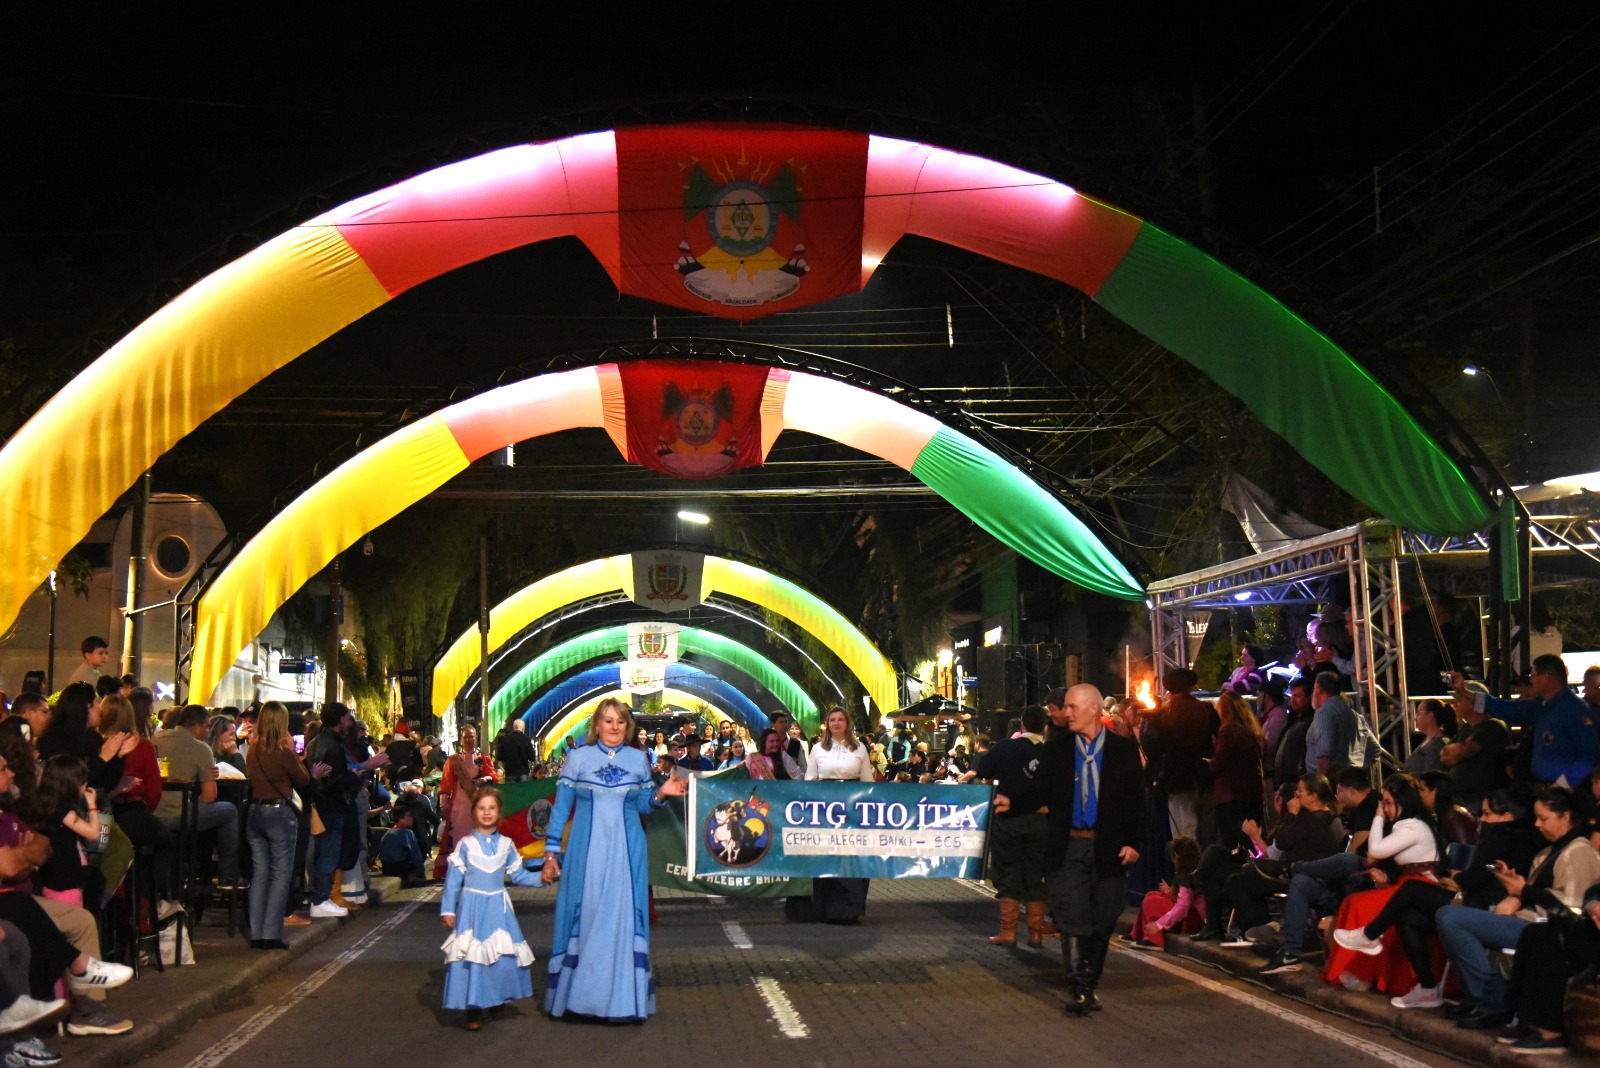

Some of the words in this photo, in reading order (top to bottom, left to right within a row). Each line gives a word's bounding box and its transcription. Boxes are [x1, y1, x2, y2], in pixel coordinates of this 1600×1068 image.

[784, 800, 847, 827] CTG
[855, 801, 908, 827] TIO
[916, 796, 979, 828] ÍTIA
[785, 832, 821, 846] CERRO
[830, 833, 868, 846] ALEGRE
[879, 834, 912, 847] BAIXO
[934, 836, 962, 848] SCS
[706, 874, 751, 887] ALEGRE
